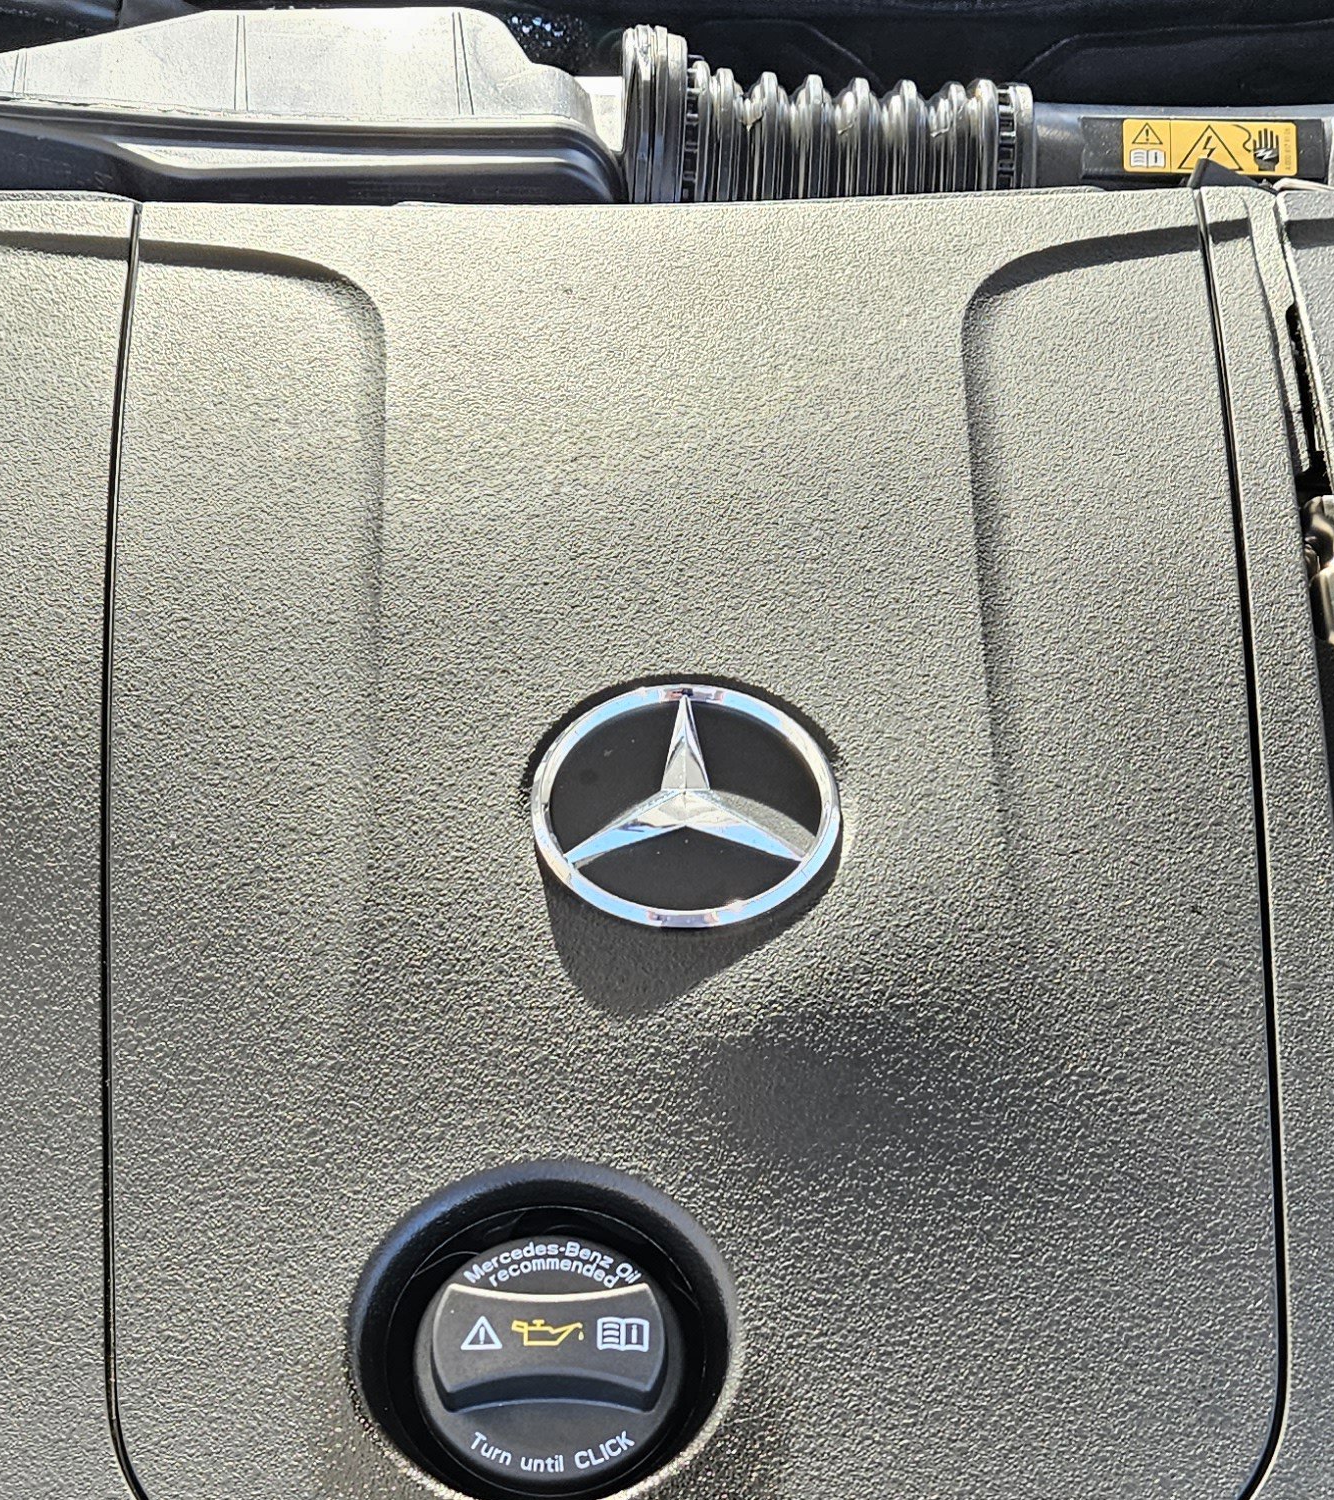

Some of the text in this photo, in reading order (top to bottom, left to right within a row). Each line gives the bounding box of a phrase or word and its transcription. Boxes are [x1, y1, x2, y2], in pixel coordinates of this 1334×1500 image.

[463, 1241, 641, 1285] Mercedes-Benz Oil
[489, 1257, 620, 1288] recommended
[470, 1430, 635, 1473] Turn until CLICK
